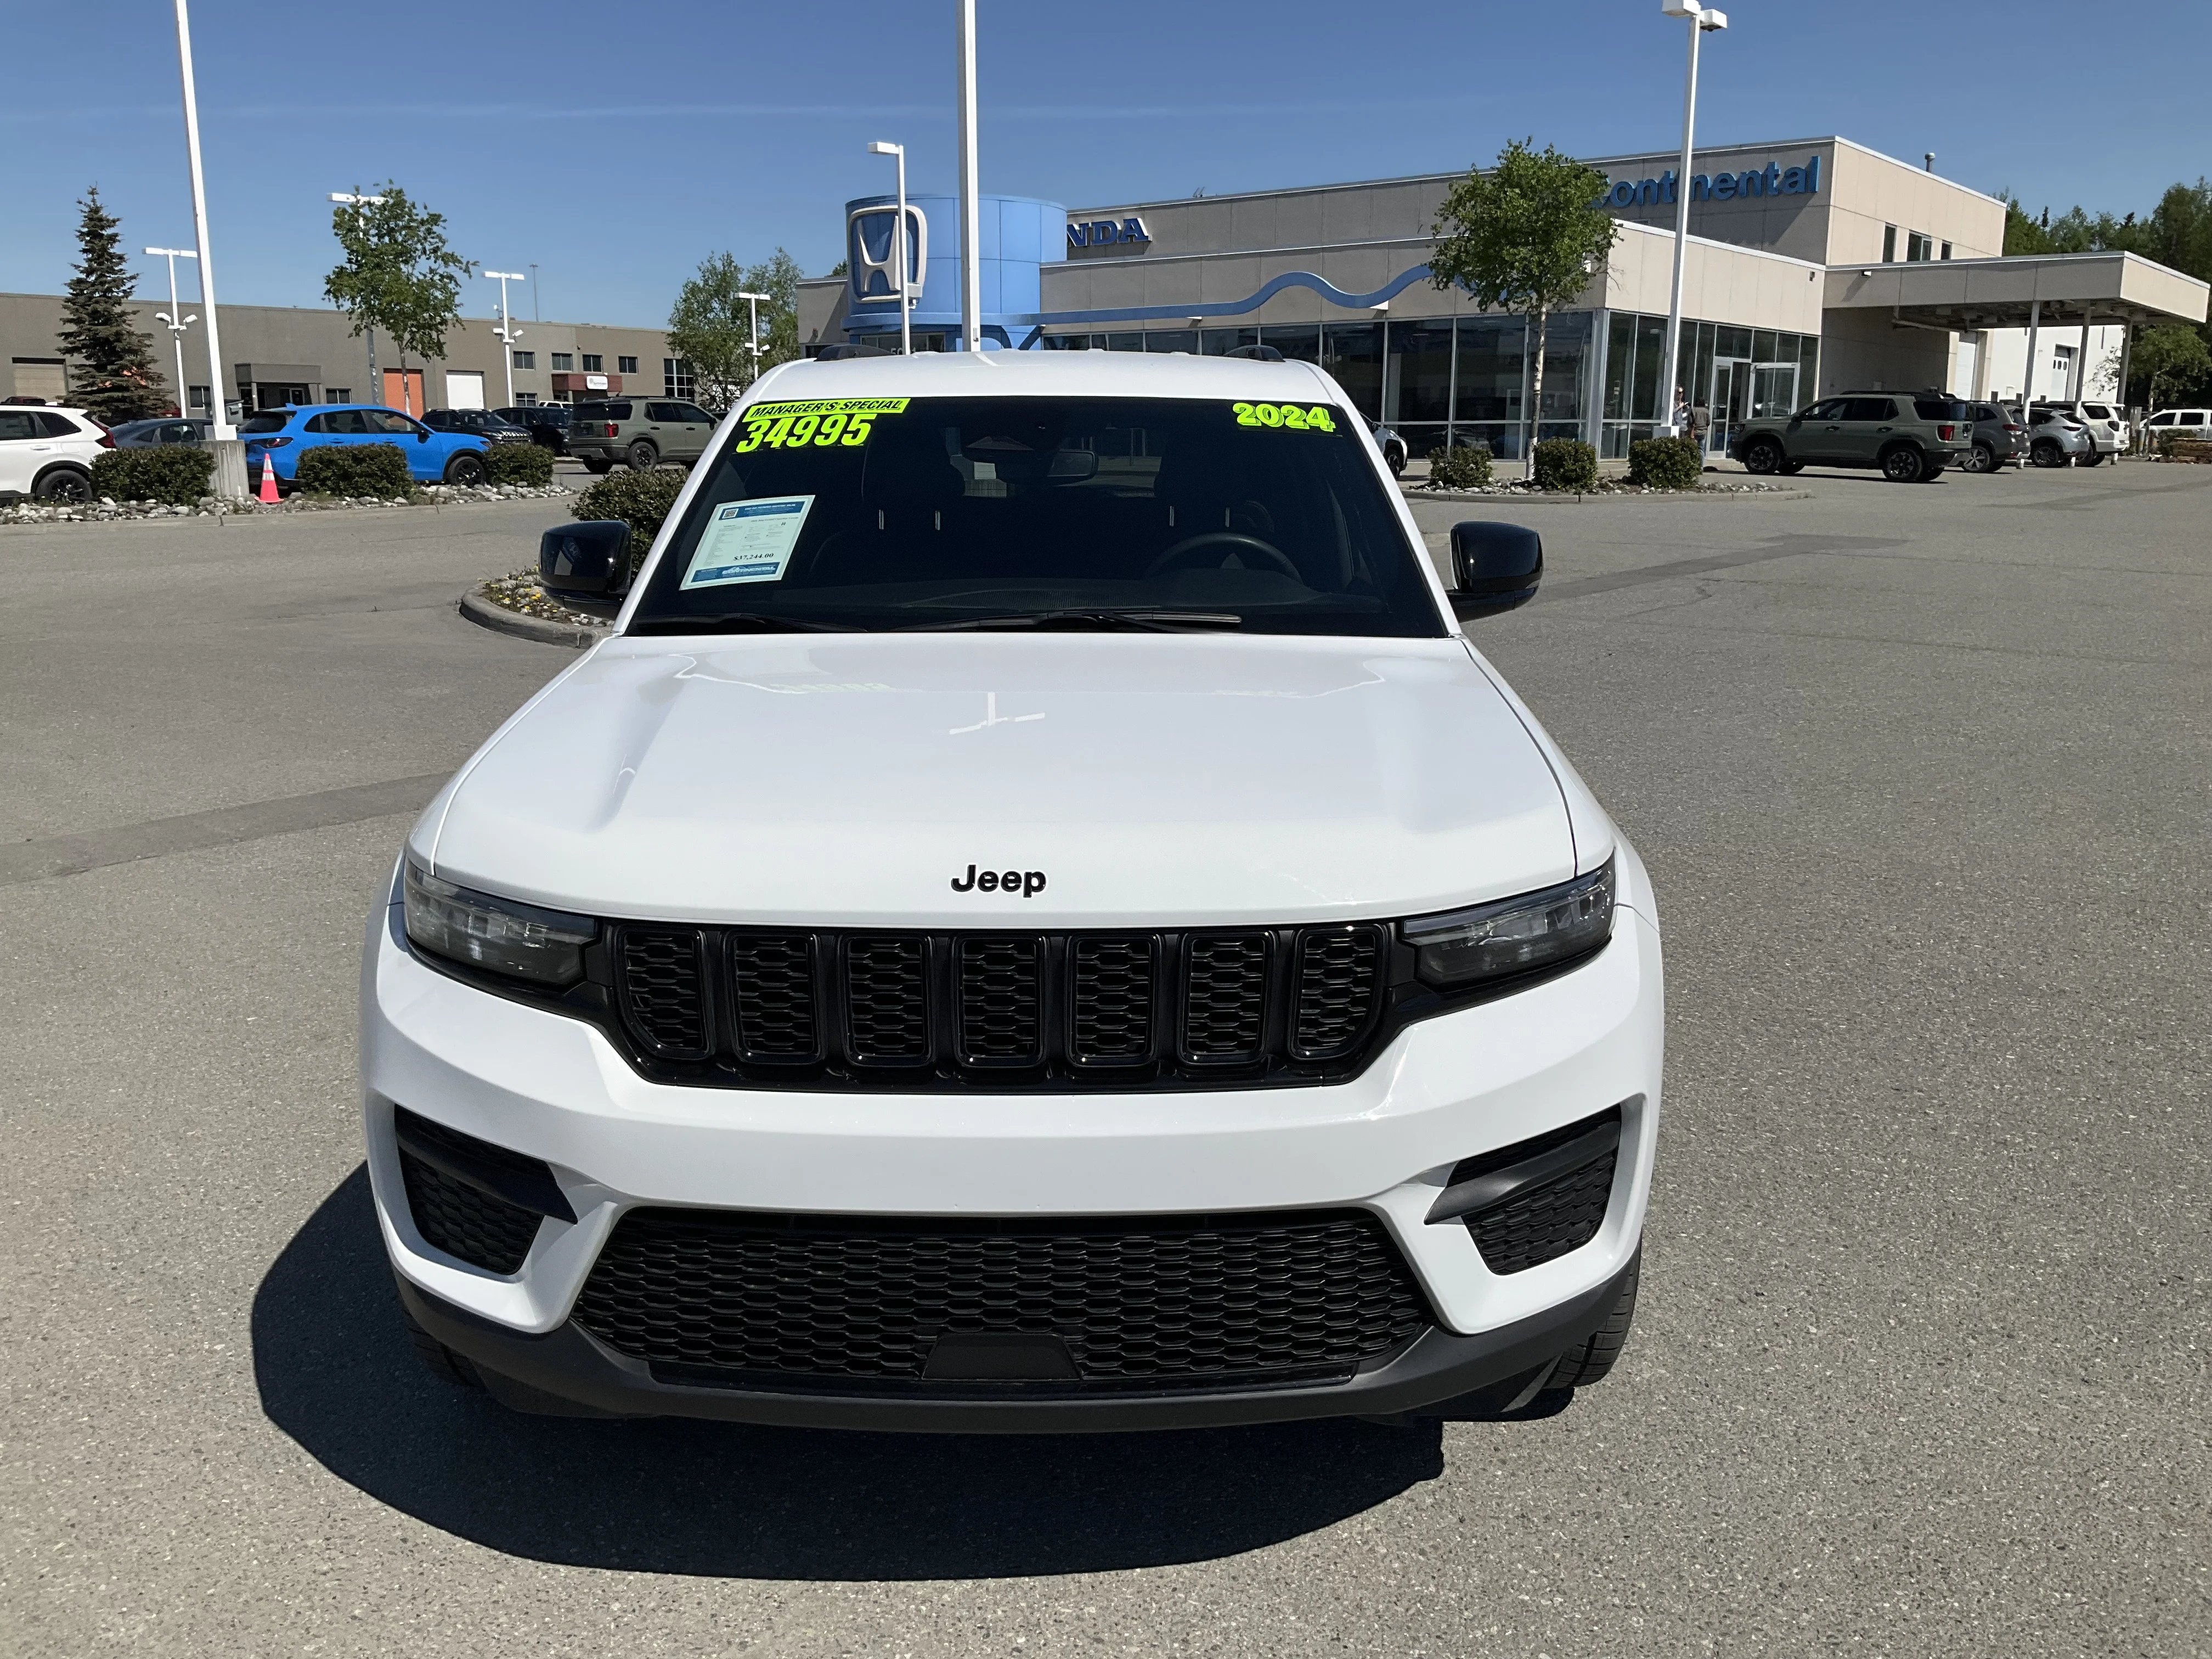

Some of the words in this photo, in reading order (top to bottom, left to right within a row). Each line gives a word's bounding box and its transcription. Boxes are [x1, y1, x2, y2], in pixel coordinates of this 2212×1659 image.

[1591, 156, 1821, 208] ontnental
[750, 402, 840, 417] MANAGER'S
[840, 400, 903, 411] SPECIAL
[1233, 402, 1336, 432] 2024
[736, 413, 877, 453] 34995
[951, 865, 1046, 898] Jeep
